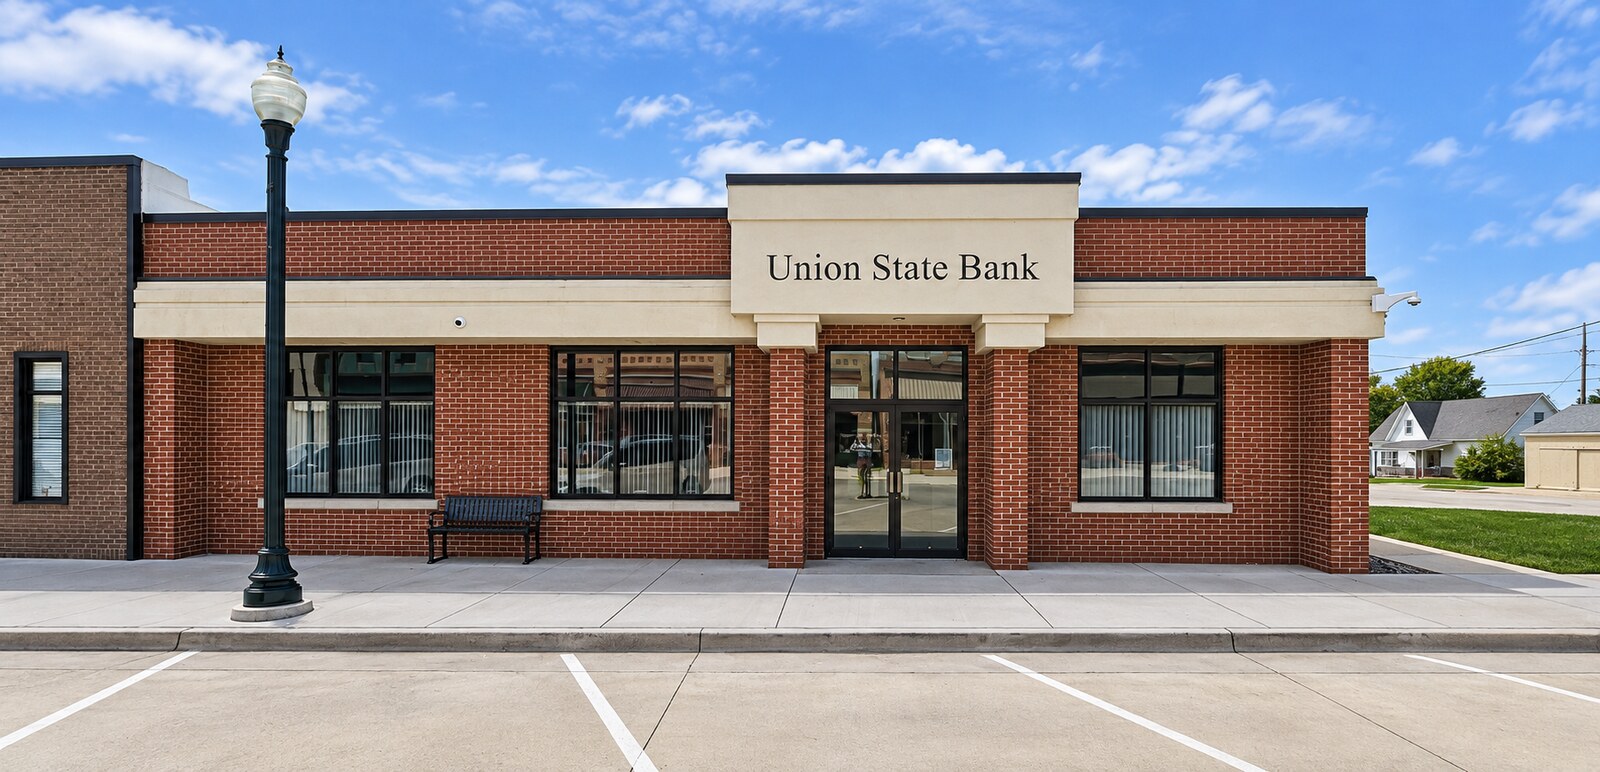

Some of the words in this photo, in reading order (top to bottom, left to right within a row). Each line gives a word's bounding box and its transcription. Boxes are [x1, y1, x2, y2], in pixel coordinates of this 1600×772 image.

[766, 253, 862, 281] Union
[872, 253, 948, 281] State
[958, 252, 1040, 281] Bank
